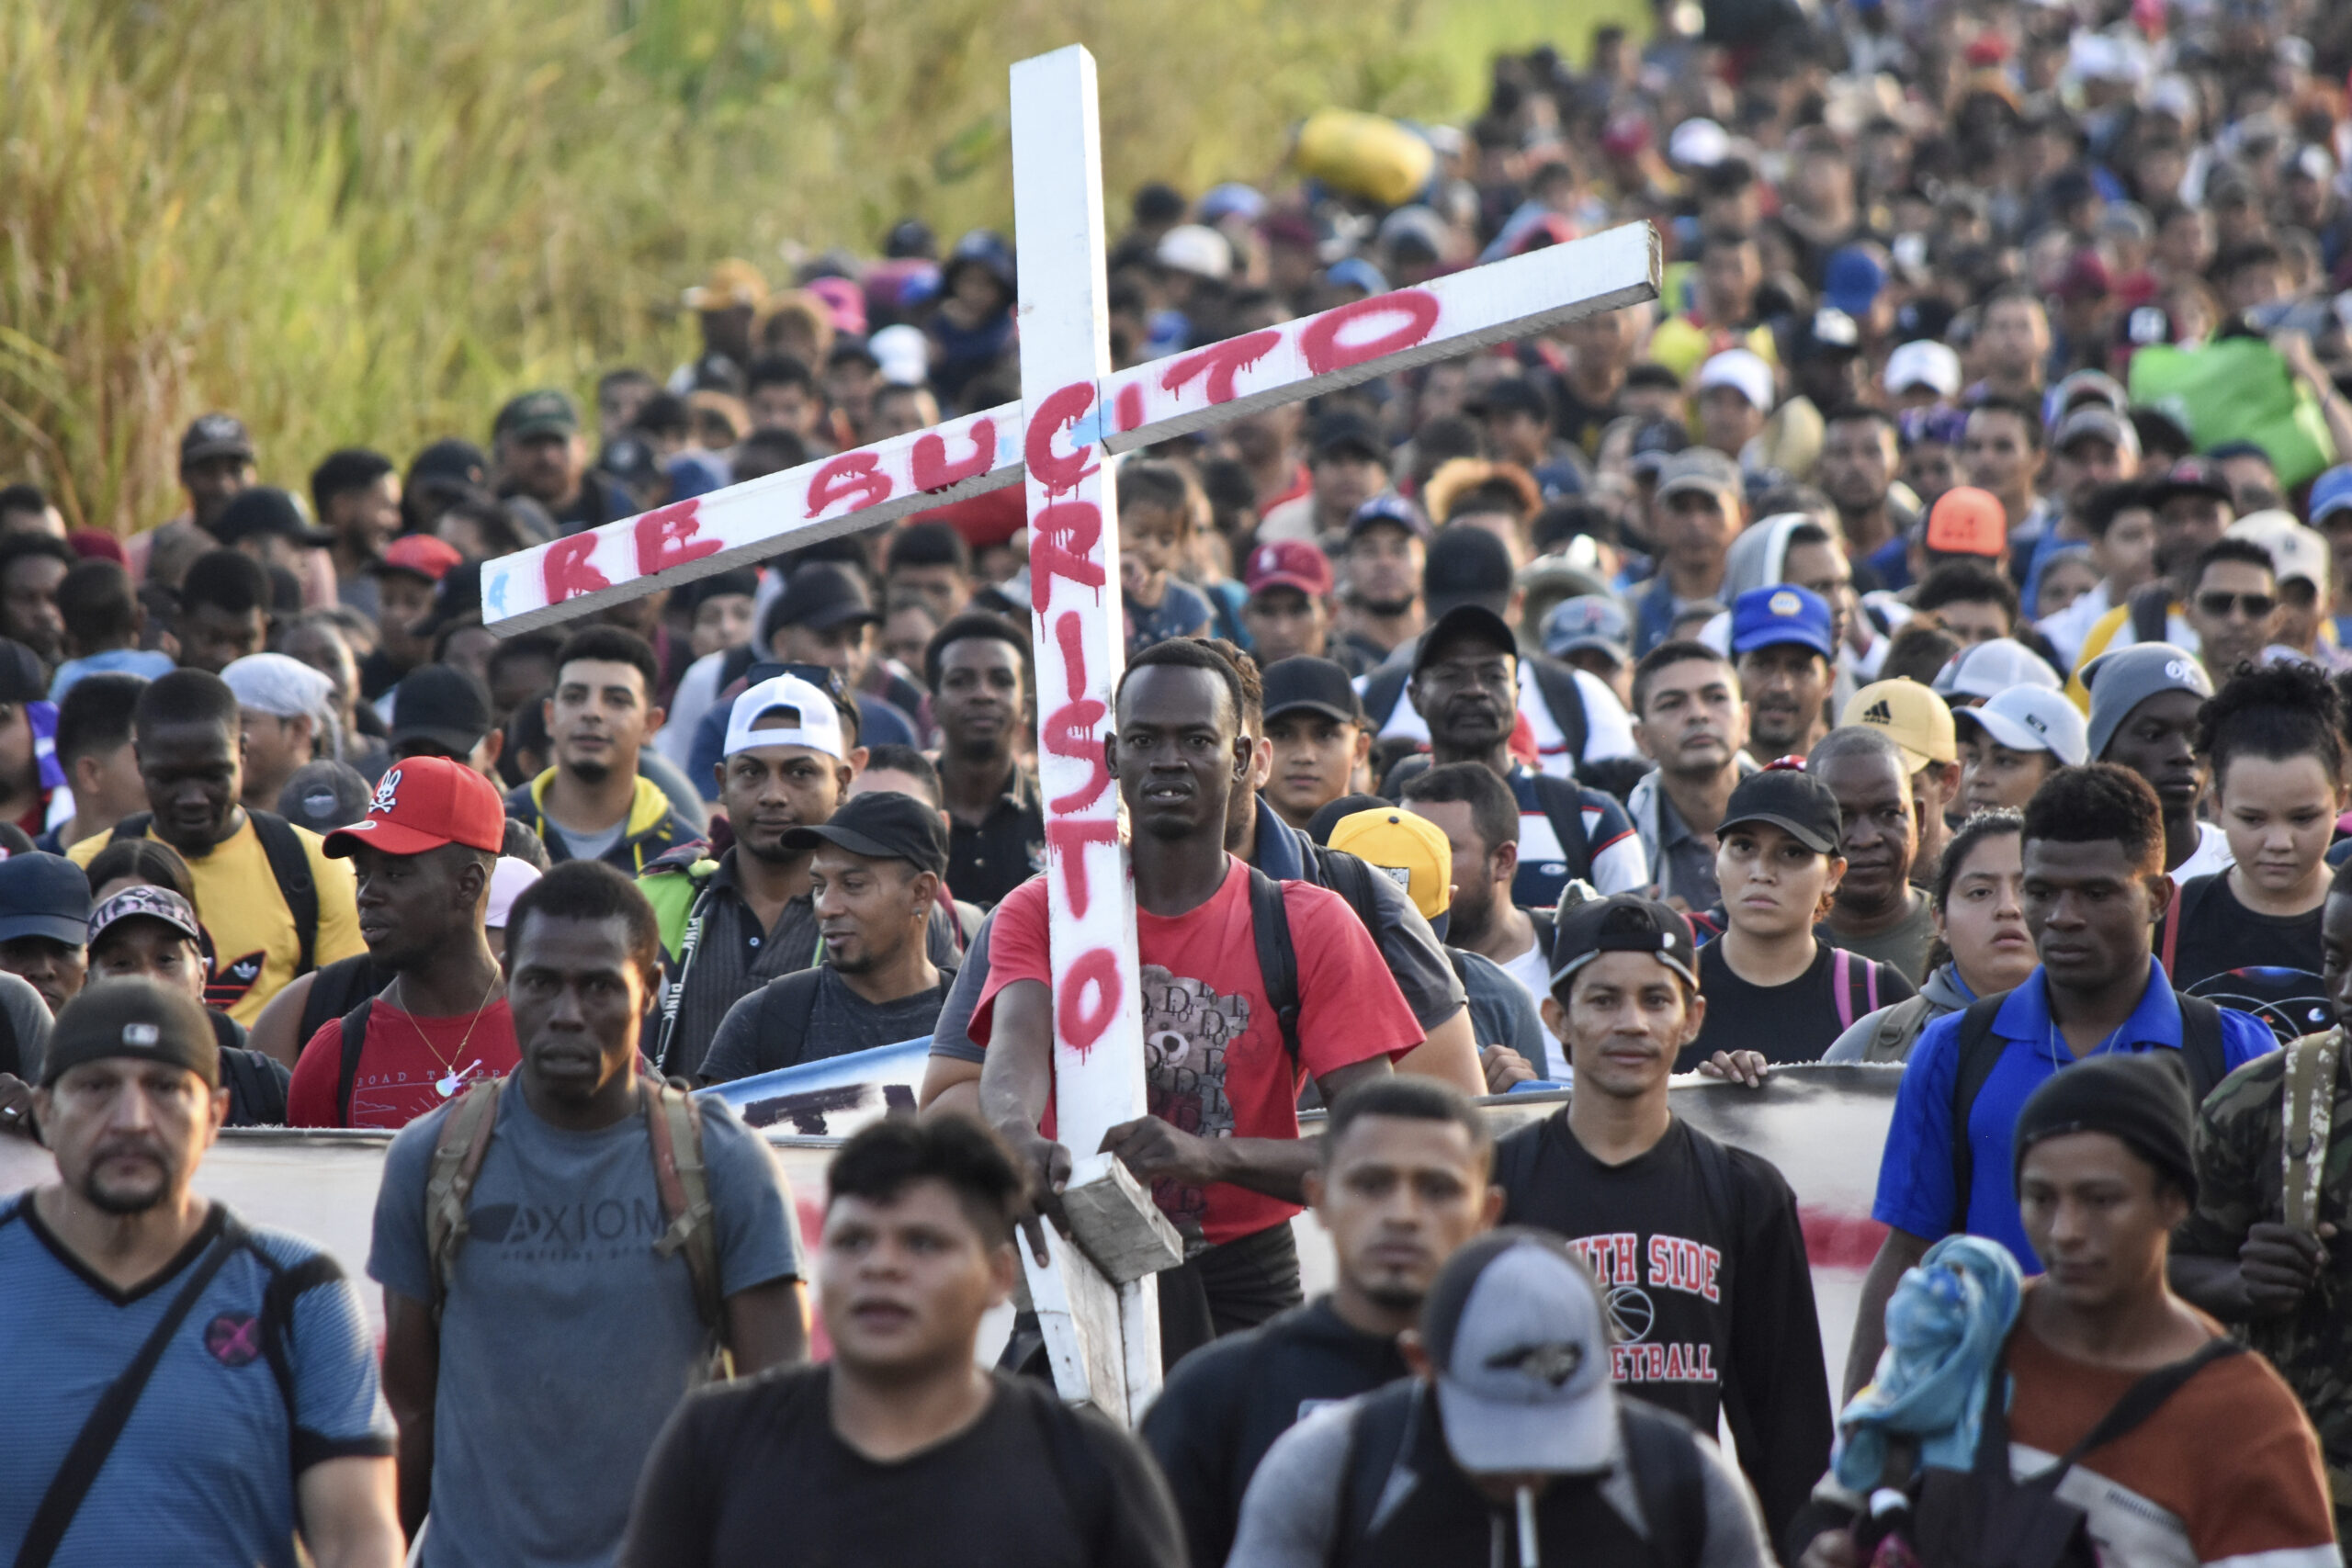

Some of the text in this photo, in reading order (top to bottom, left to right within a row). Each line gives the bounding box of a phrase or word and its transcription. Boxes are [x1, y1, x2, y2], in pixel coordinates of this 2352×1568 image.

[1023, 380, 1124, 1055] CRISTO
[682, 917, 699, 951] PINK
[662, 982, 683, 1021] PINK
[1647, 1234, 1721, 1304] SIDE
